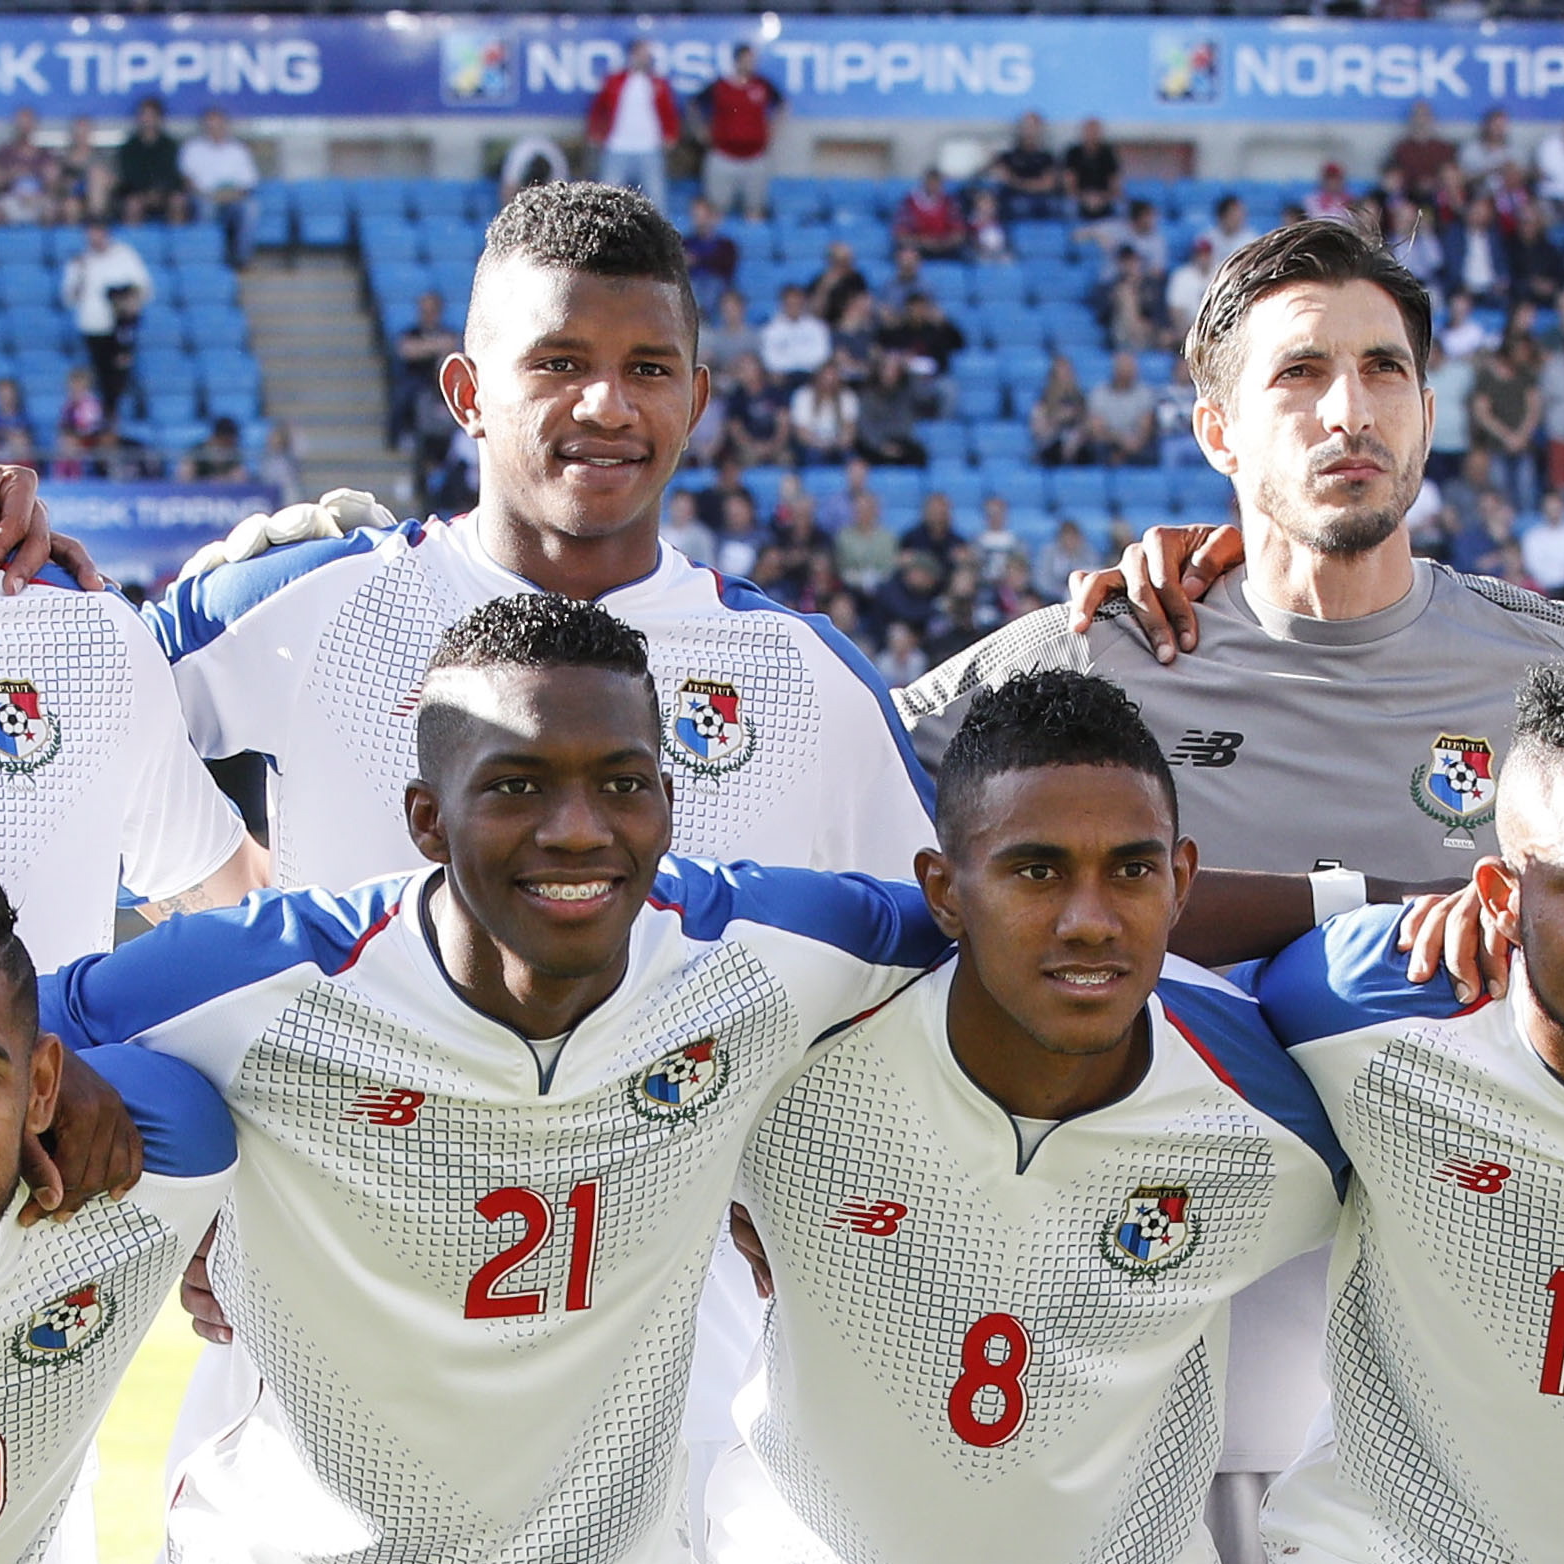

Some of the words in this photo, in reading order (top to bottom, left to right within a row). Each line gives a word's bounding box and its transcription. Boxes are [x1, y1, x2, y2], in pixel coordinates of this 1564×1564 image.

[55, 40, 322, 96] TIPPING
[774, 41, 1034, 95] TIPPING
[1237, 45, 1470, 98] NORSK
[688, 683, 732, 697] FEPAFUT
[1169, 729, 1244, 768] NB
[1440, 739, 1485, 752] FEPAFUT
[340, 1086, 425, 1127] NB
[1428, 1152, 1512, 1195] NB
[823, 1194, 909, 1237] NB
[463, 1176, 601, 1320] 21
[946, 1312, 1033, 1448] 8
